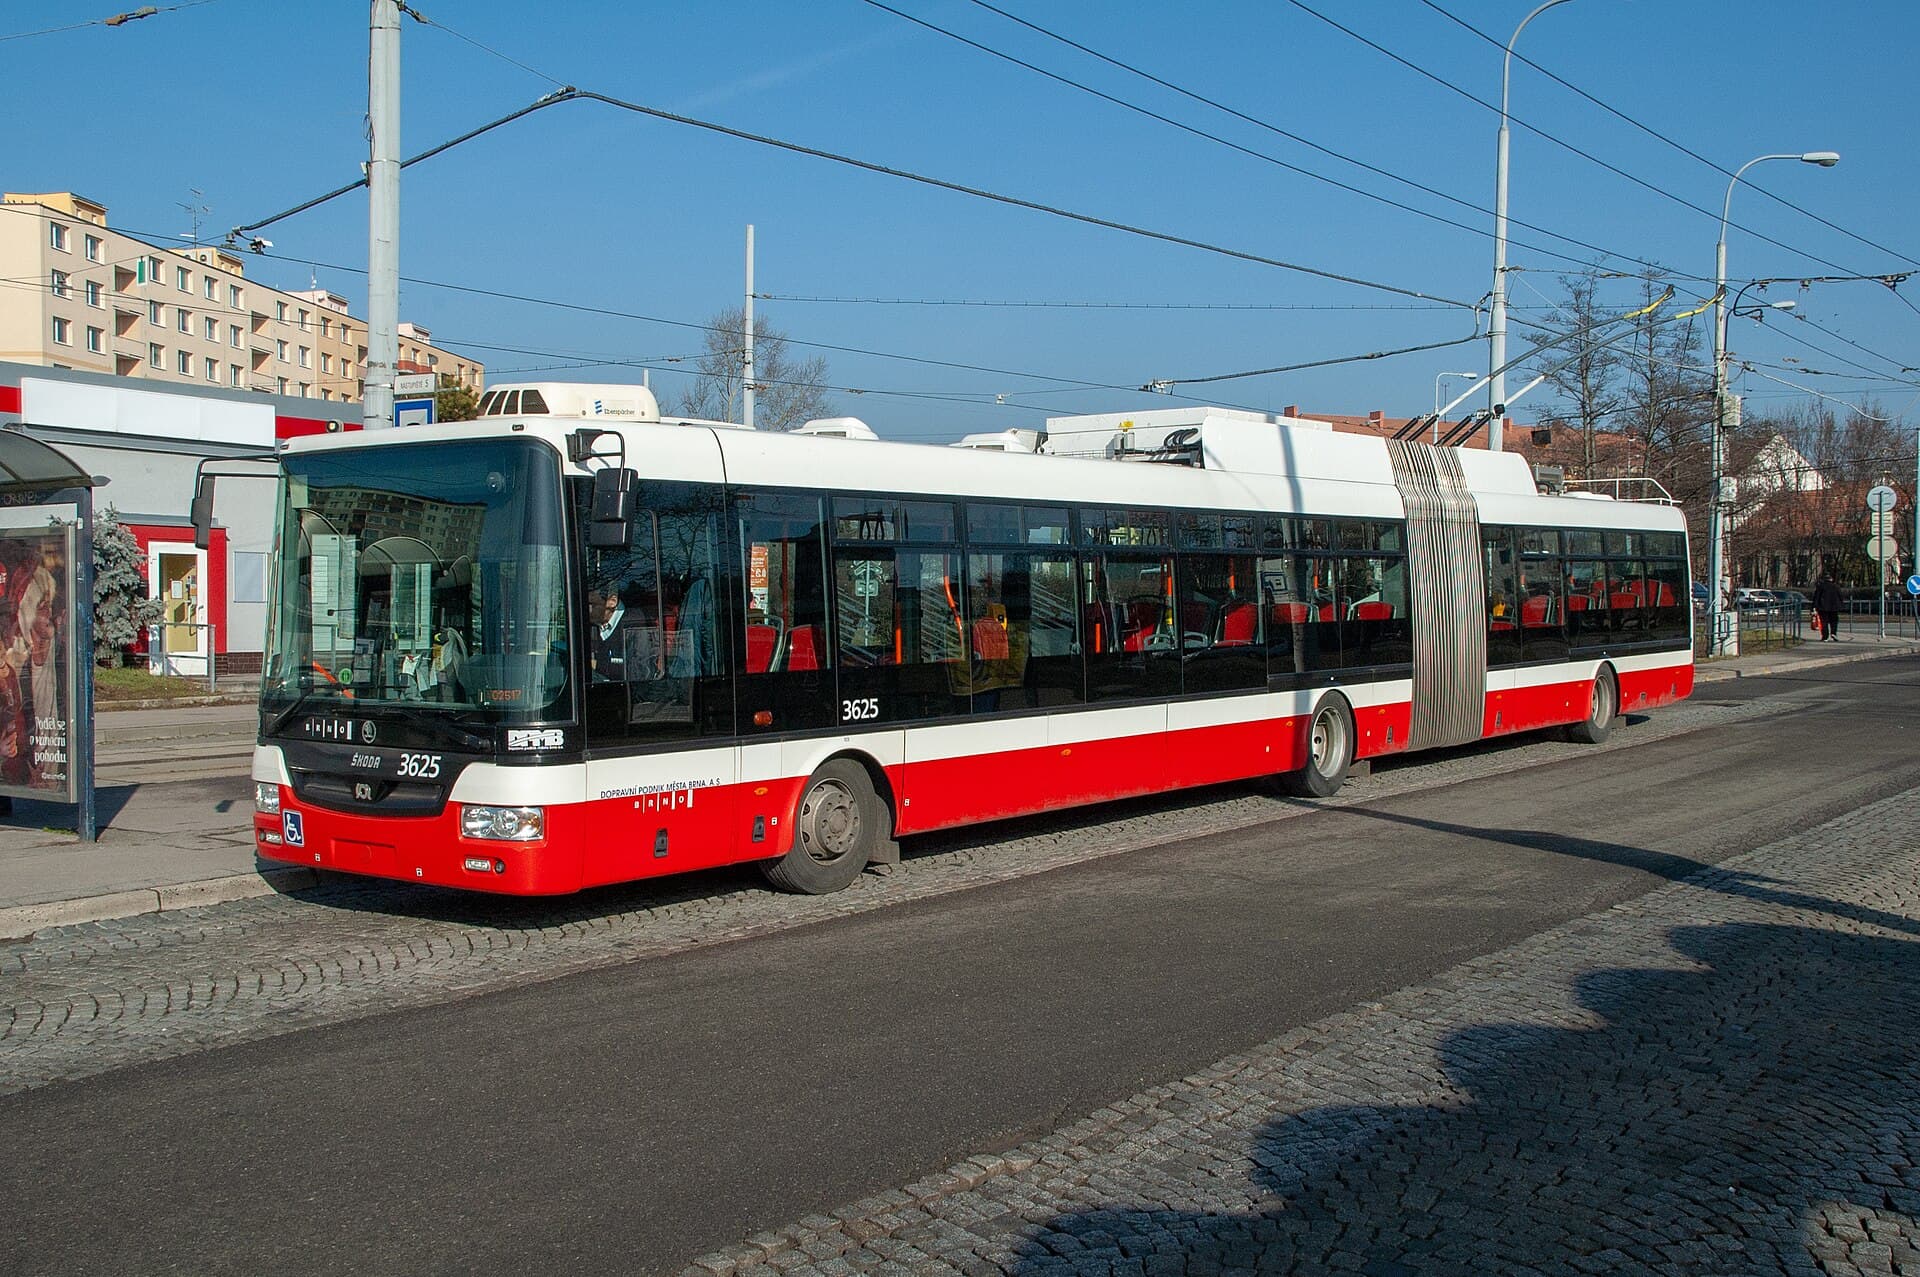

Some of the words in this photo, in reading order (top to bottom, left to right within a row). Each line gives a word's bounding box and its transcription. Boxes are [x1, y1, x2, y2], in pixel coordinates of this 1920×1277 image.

[842, 698, 879, 720] 3625
[34, 749, 67, 765] pohodu
[351, 752, 381, 769] ŠKODA
[397, 753, 442, 778] 3625
[600, 784, 638, 799] DOPRAVNÍ
[638, 783, 665, 794] PODNIK
[688, 779, 706, 791] BRNA
[634, 791, 689, 812] BRNO
